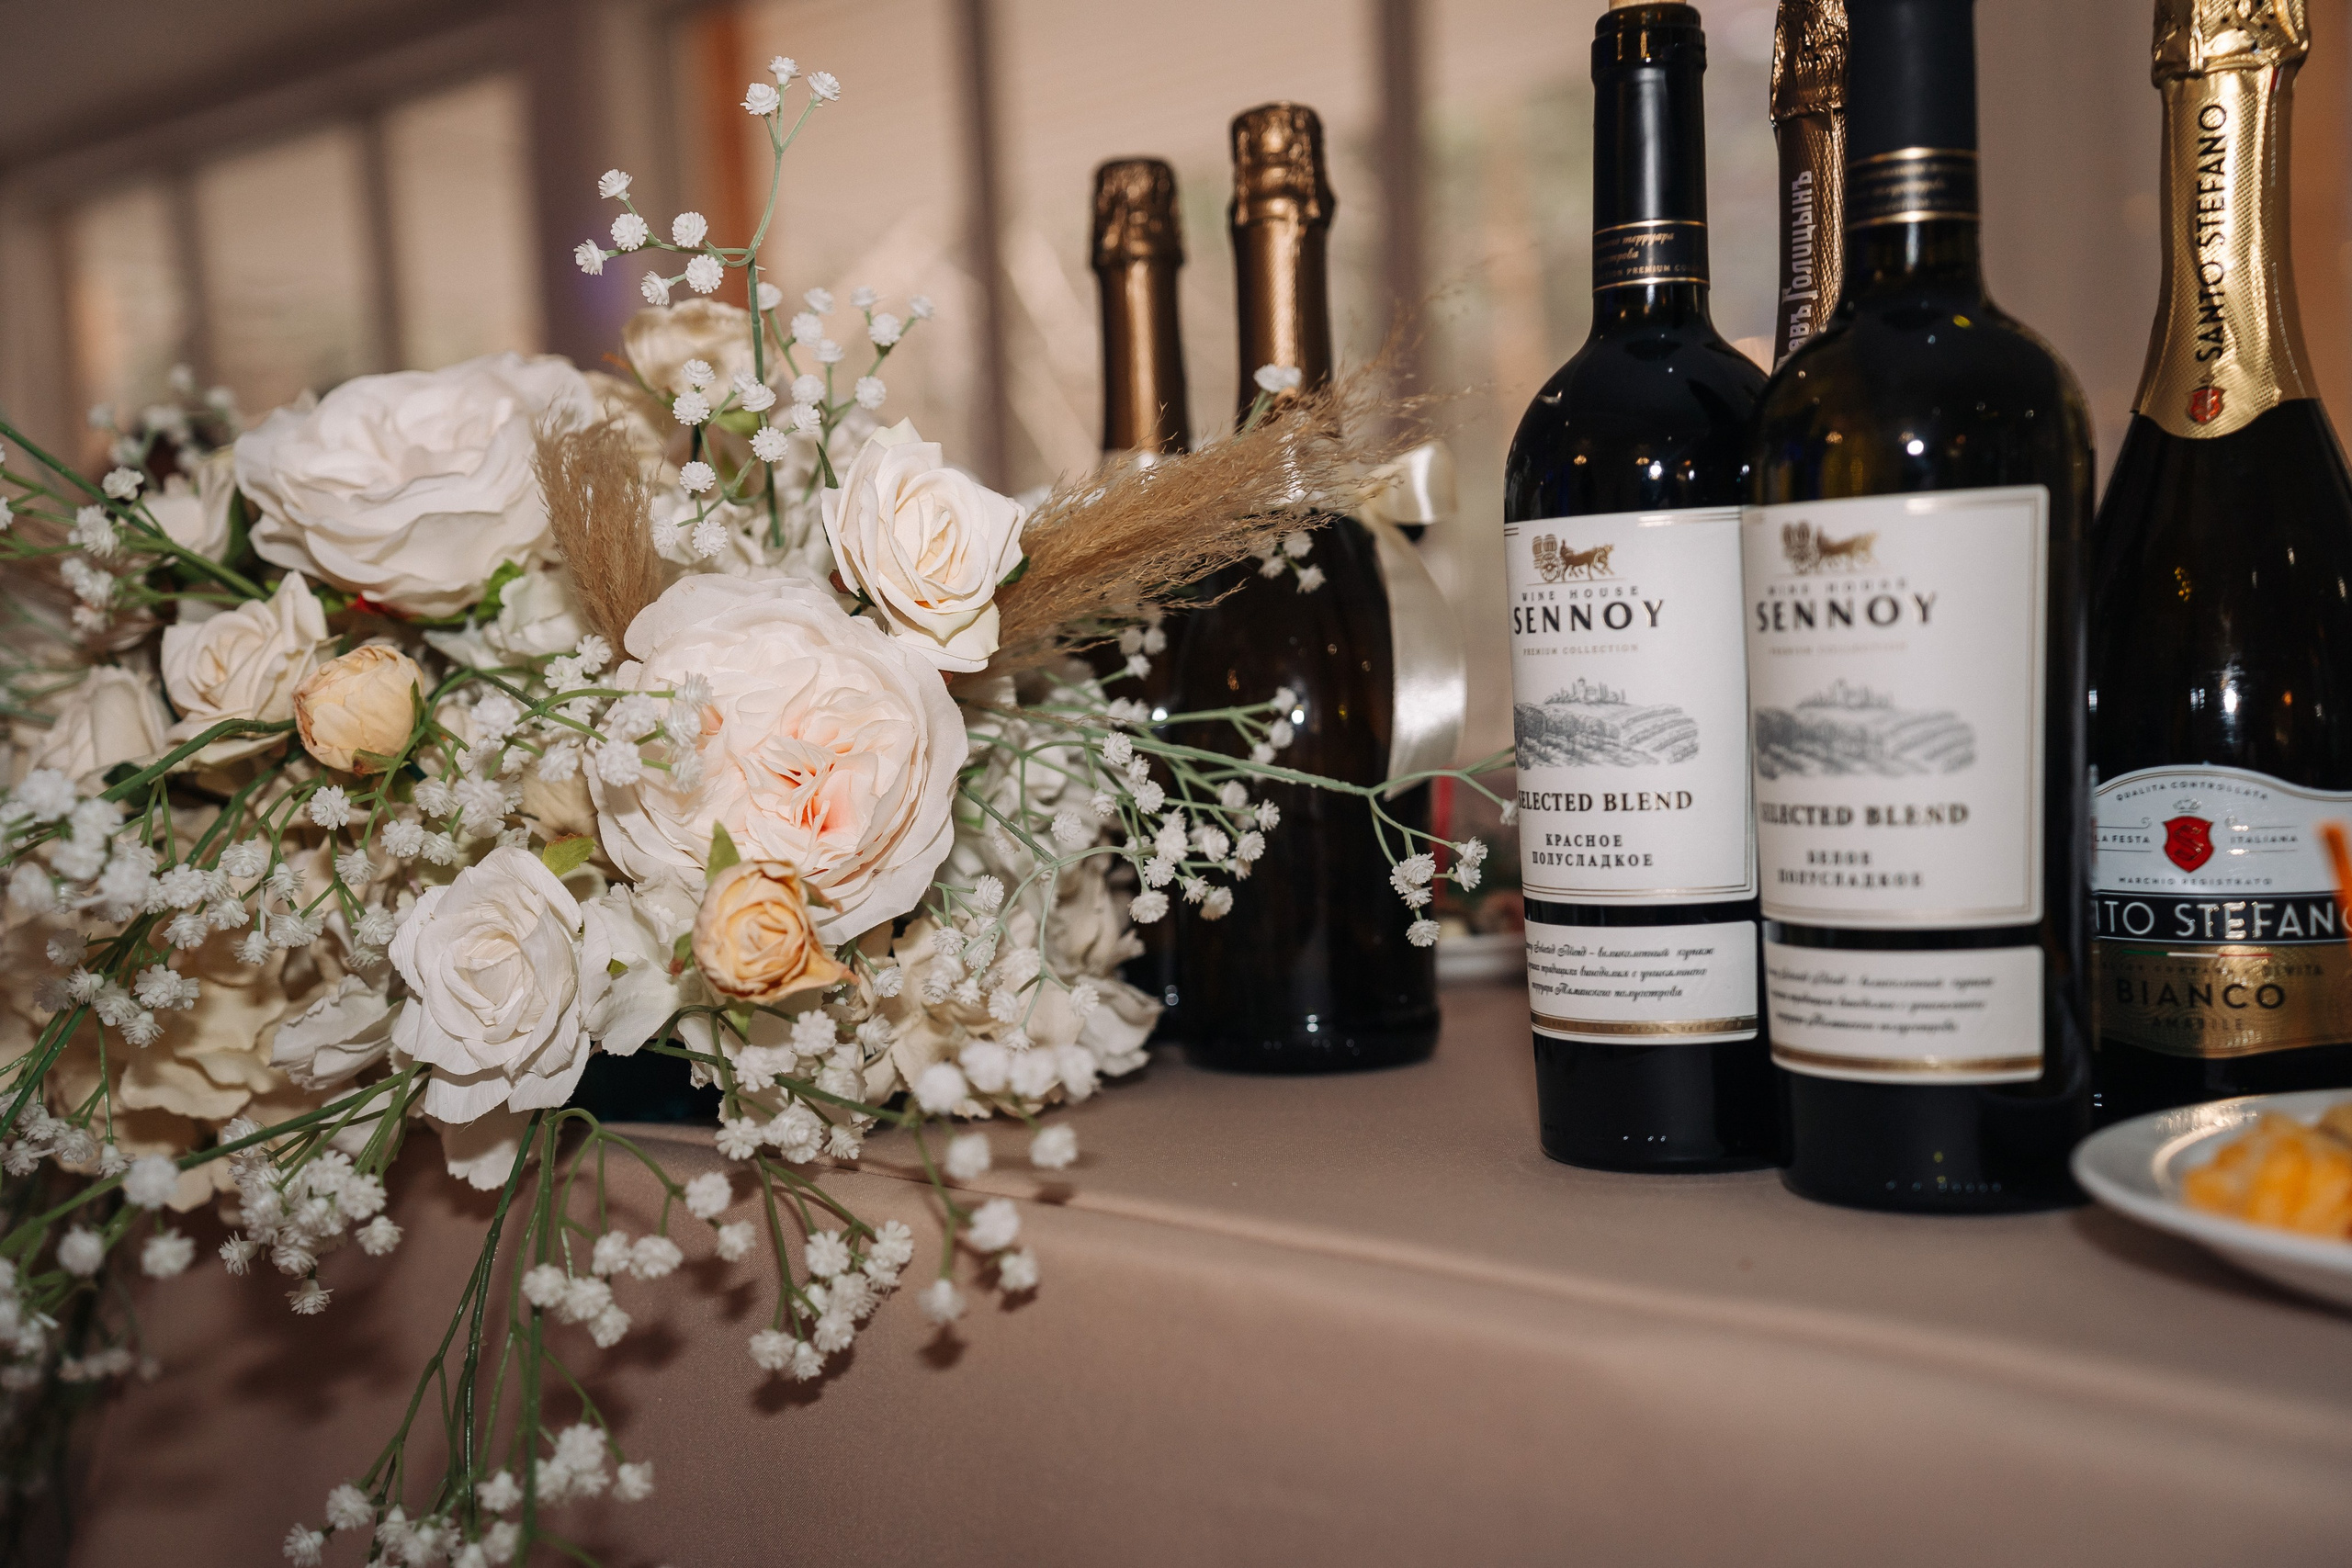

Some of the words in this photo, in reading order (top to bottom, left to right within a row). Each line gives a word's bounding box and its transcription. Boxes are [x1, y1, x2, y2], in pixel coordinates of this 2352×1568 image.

[2196, 104, 2227, 247] STEFANO
[1781, 170, 1819, 306] Голицынъ
[1626, 265, 1670, 275] PREMIUM
[2195, 262, 2226, 362] SANTO
[1521, 591, 1555, 602] WINE
[1569, 586, 1639, 599] HOUSE
[1514, 599, 1664, 635] SENNOY
[1756, 593, 1937, 632] SENNOY
[1522, 648, 1558, 656] PREMIUM
[1562, 643, 1639, 655] COLLECTION
[1518, 790, 1593, 812] SELECTED
[1602, 790, 1693, 812] BLEND
[2116, 784, 2166, 801] QUALITA
[2170, 782, 2268, 800] CONTROLLATA
[1865, 803, 1970, 826] BLEND
[1545, 833, 1623, 847] КРАСНОЕ
[2112, 835, 2150, 843] FESTA
[2230, 835, 2297, 844] ITALIANA
[1532, 851, 1653, 869] ПОЛУСЛАДКОЕ
[2119, 877, 2176, 886] MARCHIO
[2182, 877, 2273, 886] REGISTRATO
[2095, 900, 2154, 935] TO
[2116, 978, 2285, 1010] BIANCO
